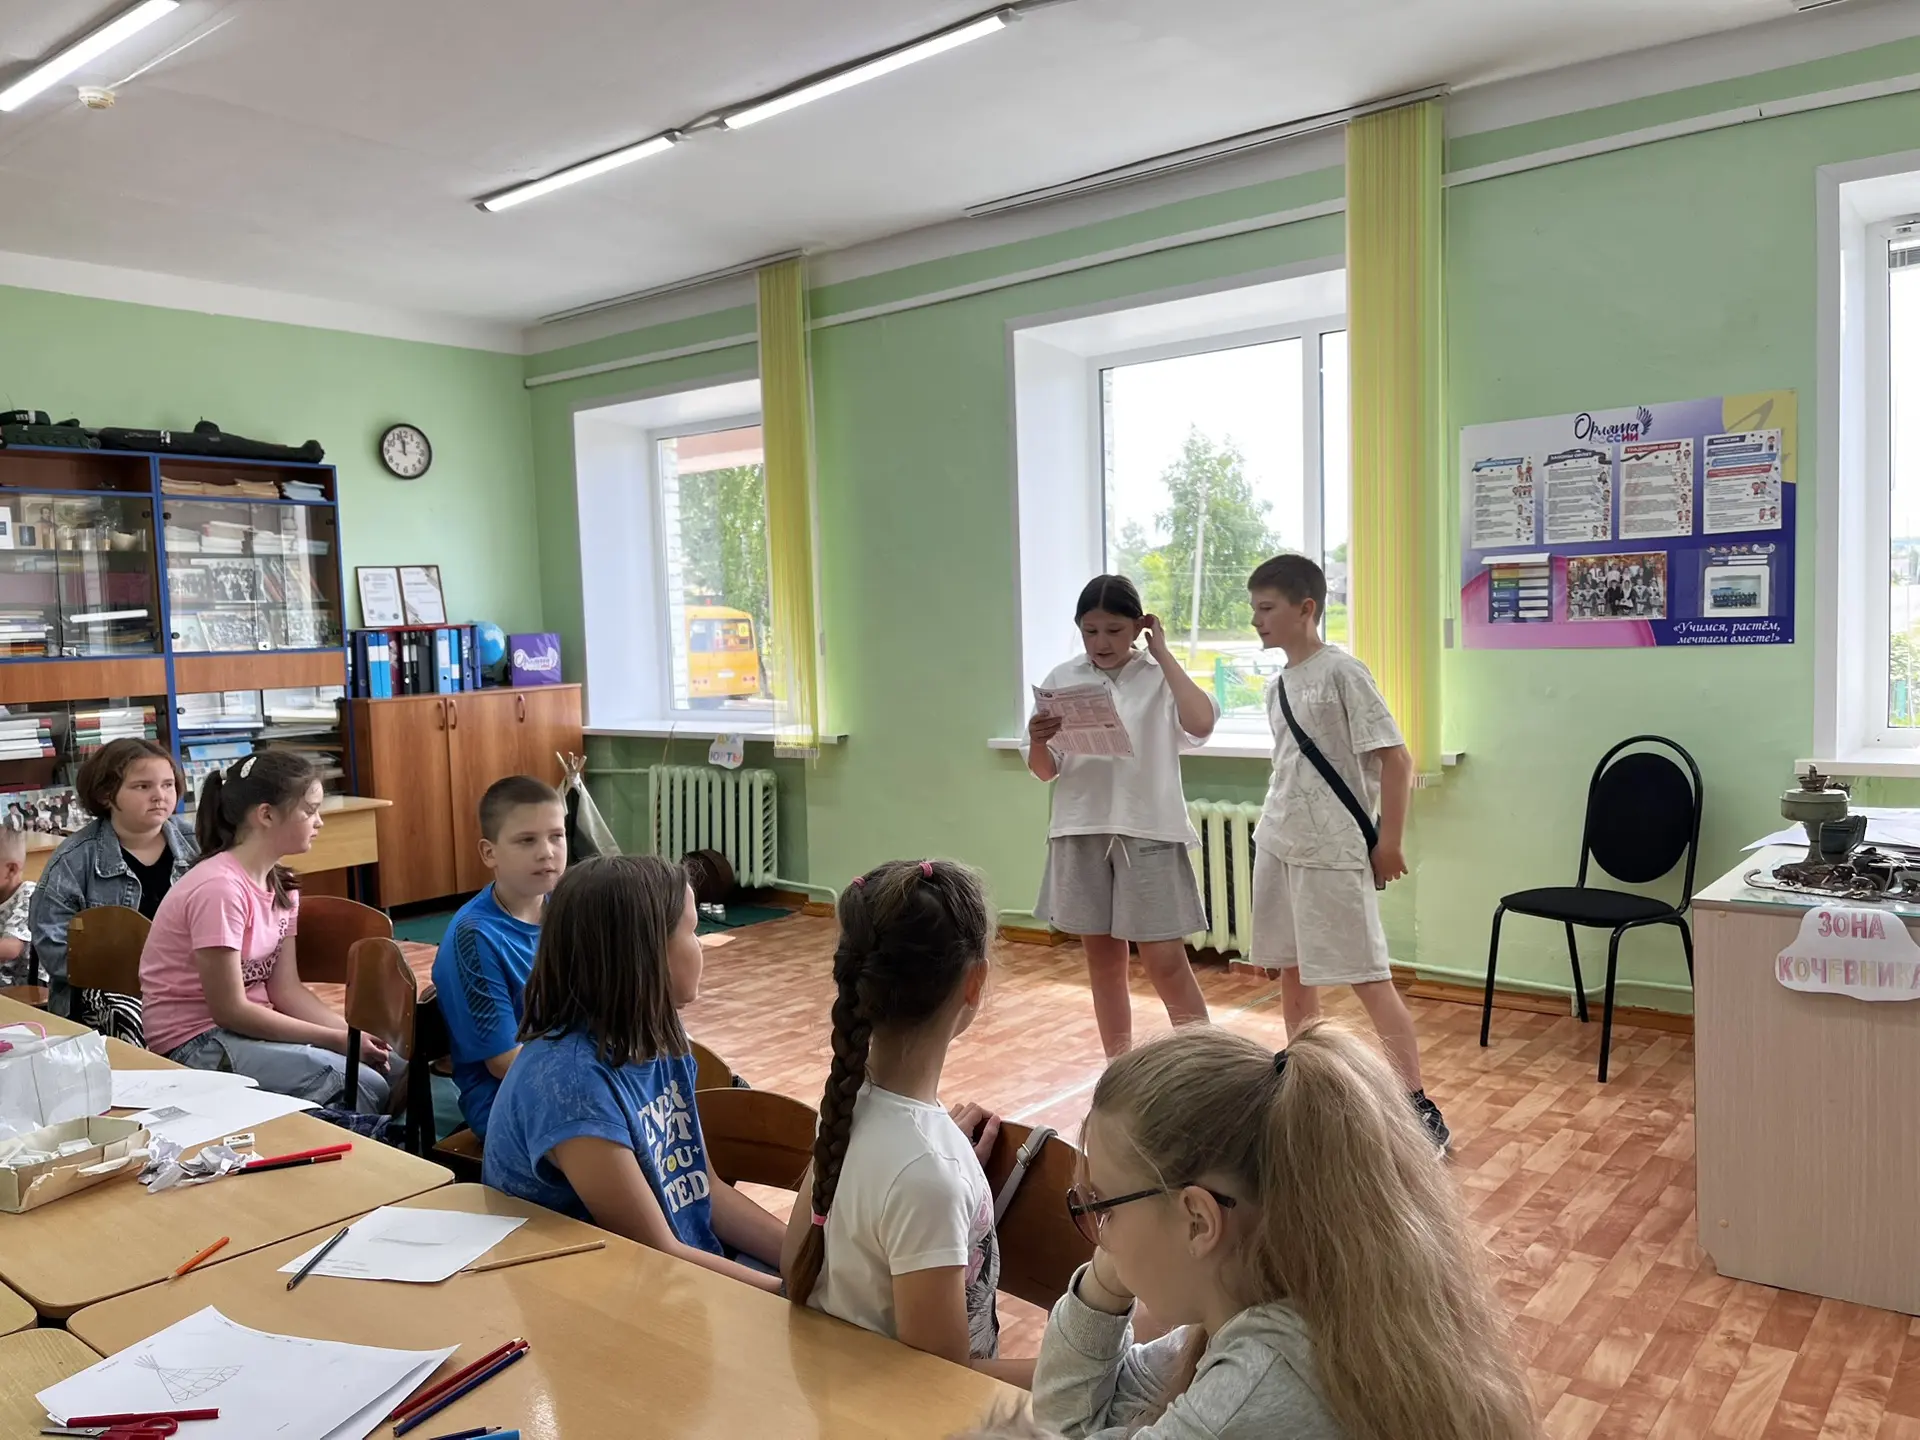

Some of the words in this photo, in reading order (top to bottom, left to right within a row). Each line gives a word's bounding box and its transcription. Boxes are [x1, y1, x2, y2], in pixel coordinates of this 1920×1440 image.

[1574, 413, 1639, 441] Орлята
[1673, 621, 1728, 634] «Учимся,
[1731, 620, 1781, 634] растём,
[1677, 635, 1728, 645] мечтаем
[1730, 632, 1781, 644] вместе!»
[1818, 911, 1886, 939] ЗОНА
